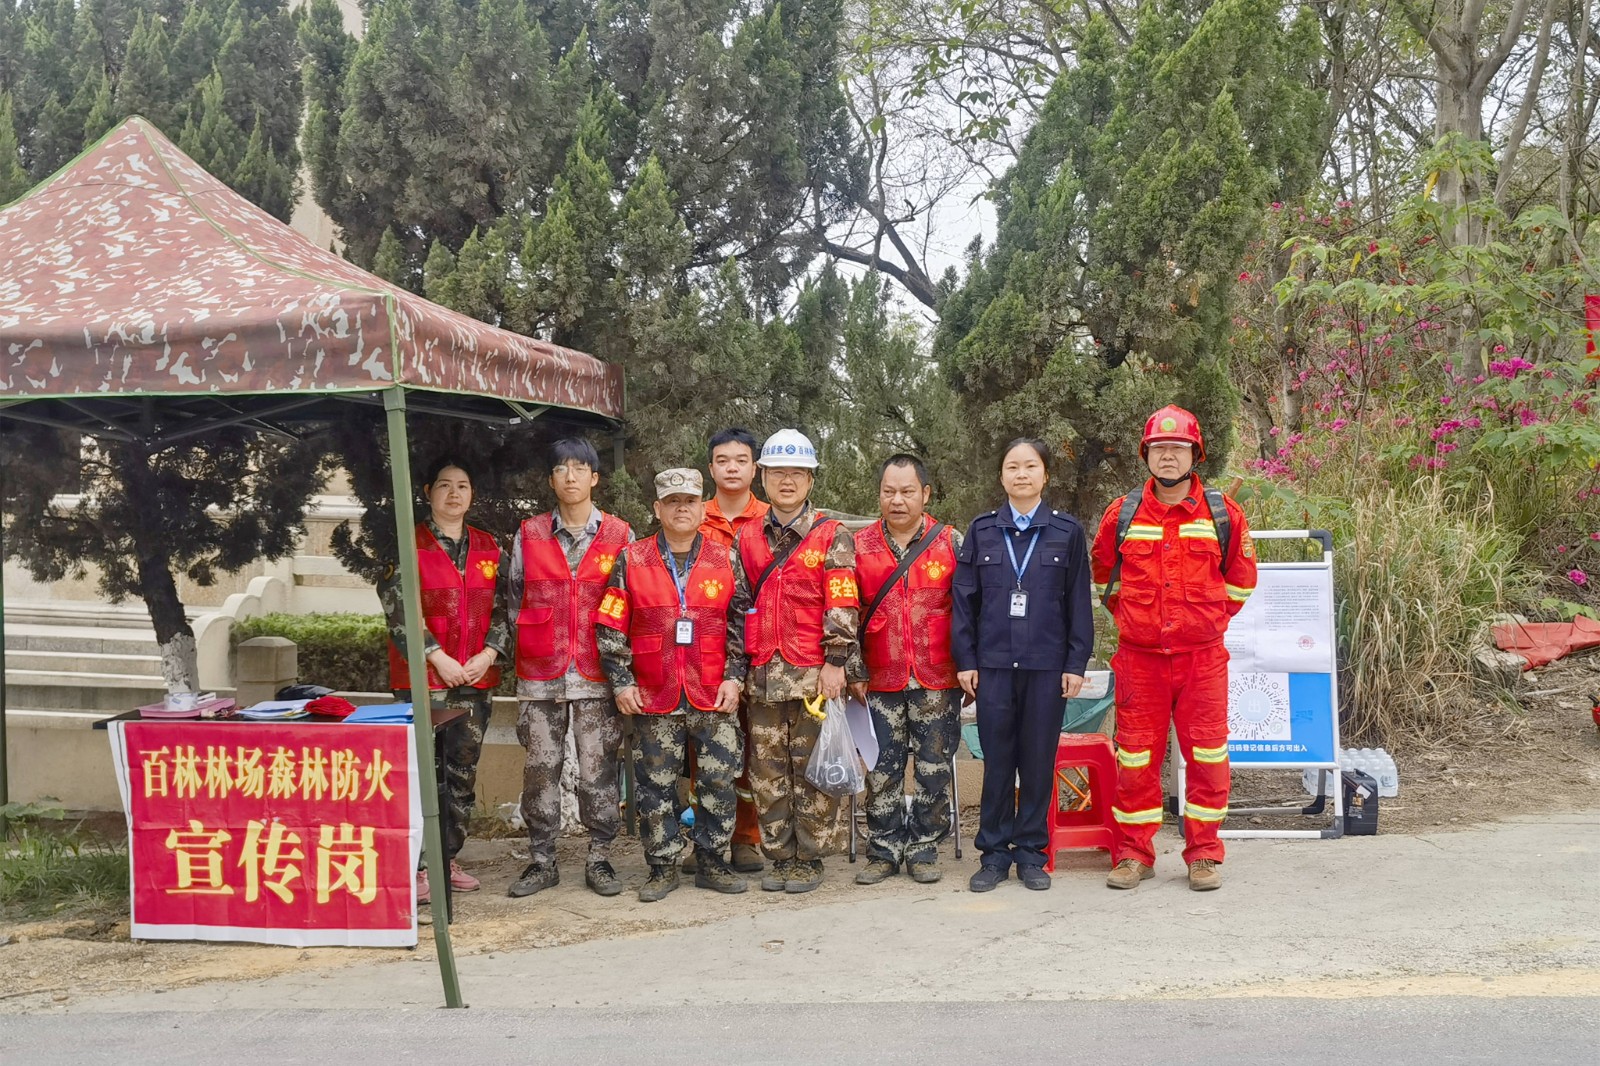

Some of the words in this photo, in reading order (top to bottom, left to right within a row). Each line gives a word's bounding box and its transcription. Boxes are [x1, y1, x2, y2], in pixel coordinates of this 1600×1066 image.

[597, 593, 625, 619] 巡查
[139, 745, 394, 801] 百林林场森林防火
[165, 819, 380, 905] 宣传岗
